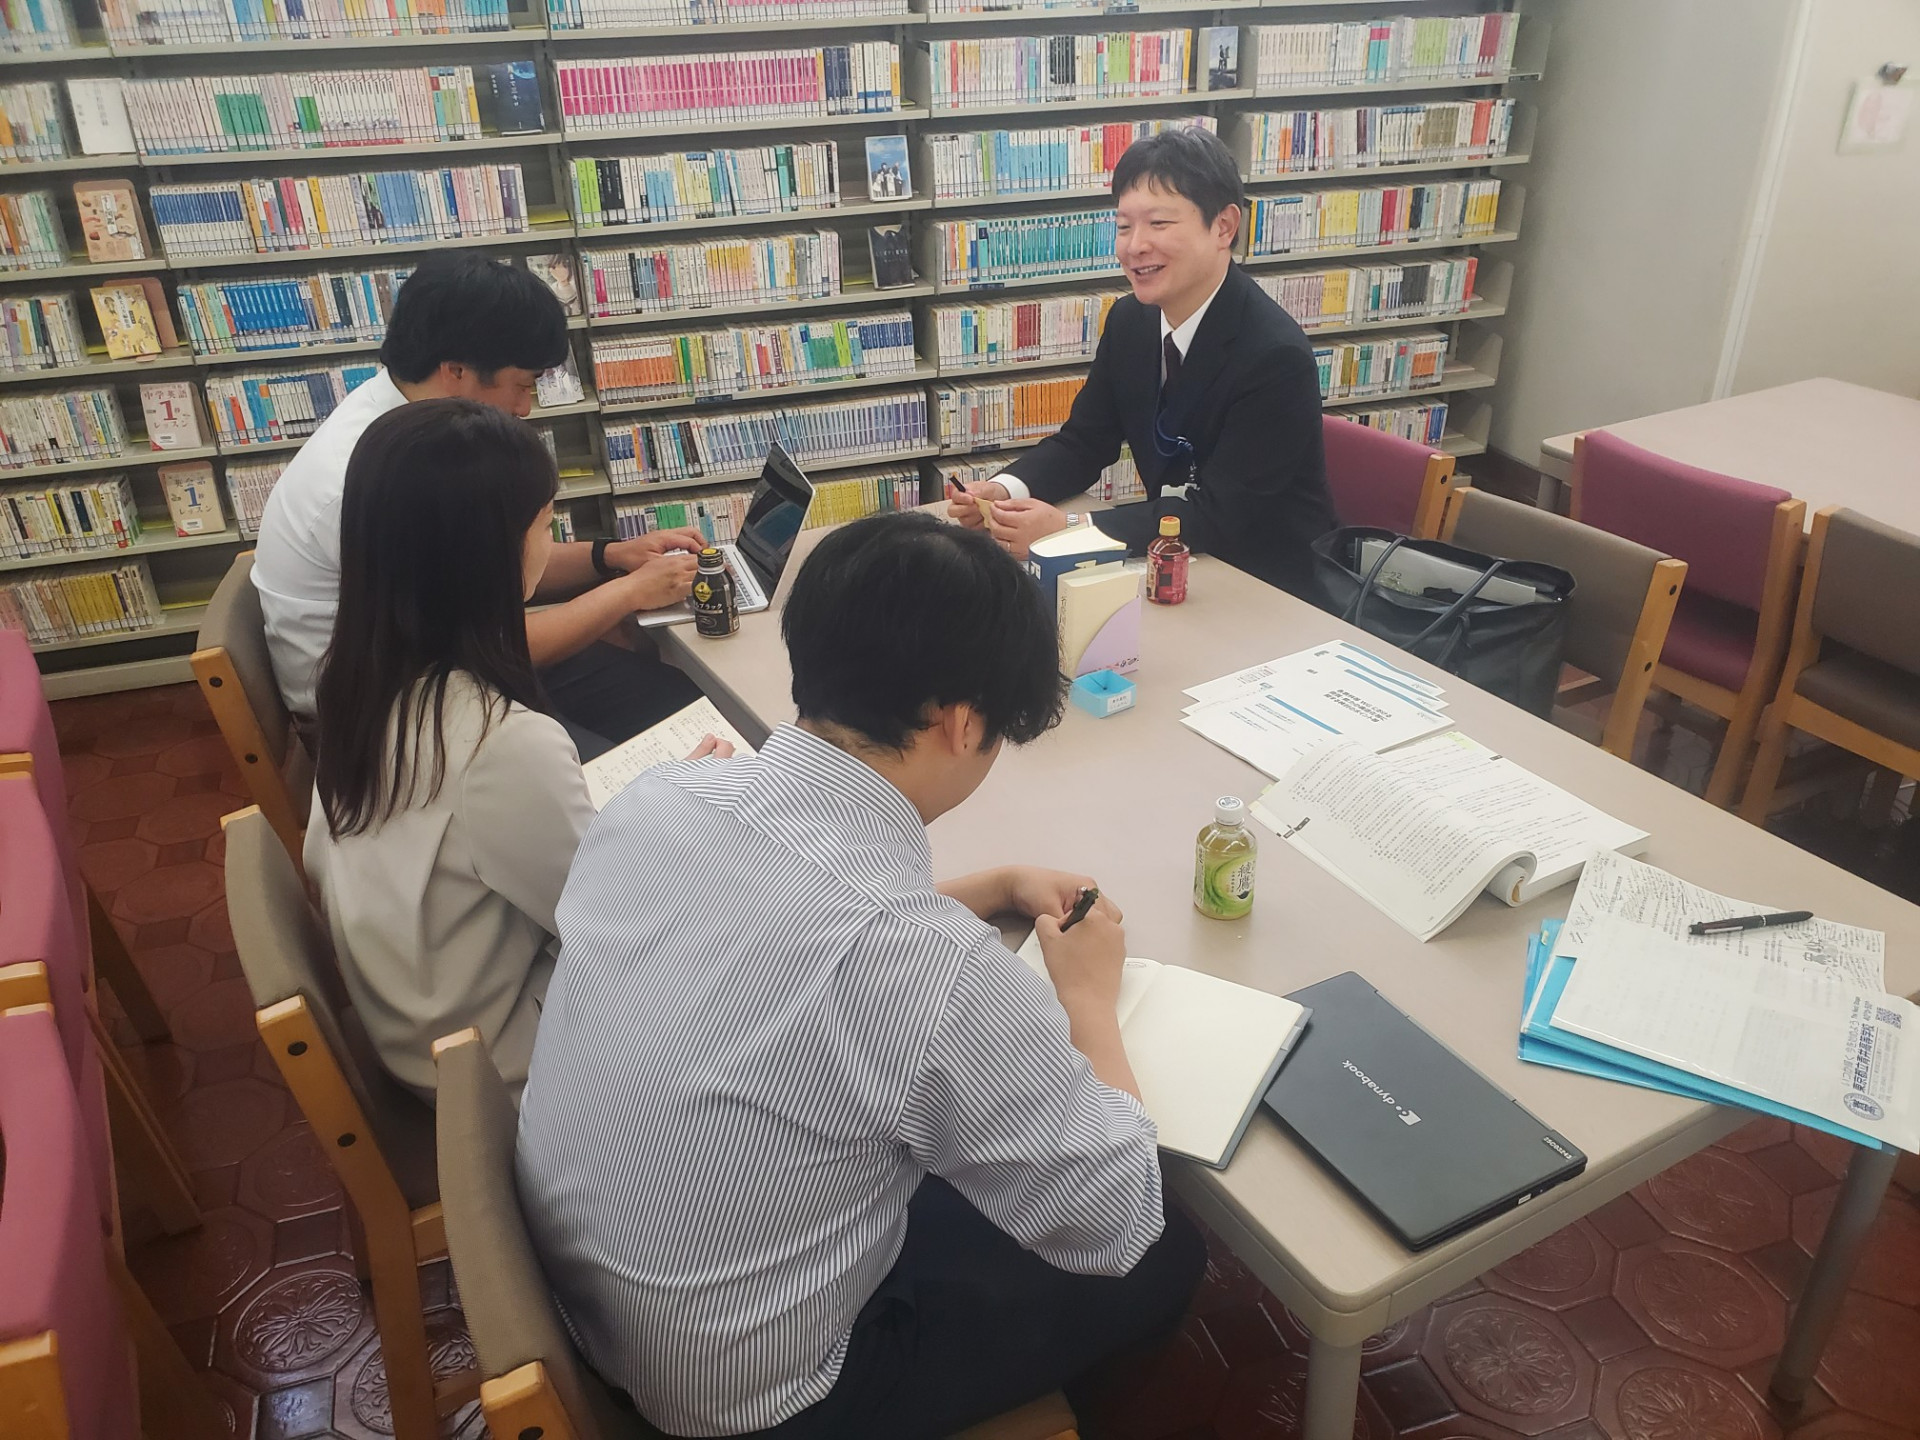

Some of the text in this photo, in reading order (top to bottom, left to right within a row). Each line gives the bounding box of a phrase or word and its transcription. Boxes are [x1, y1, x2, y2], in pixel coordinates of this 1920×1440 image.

[144, 390, 188, 400] 中学英語
[153, 420, 188, 429] レッスン
[175, 476, 206, 488] 英会話
[179, 505, 213, 515] レッスン
[1237, 862, 1252, 892] 綾鷹
[1853, 1023, 1875, 1093] 東京都立青井高等学校
[1342, 1060, 1395, 1104] dynabook
